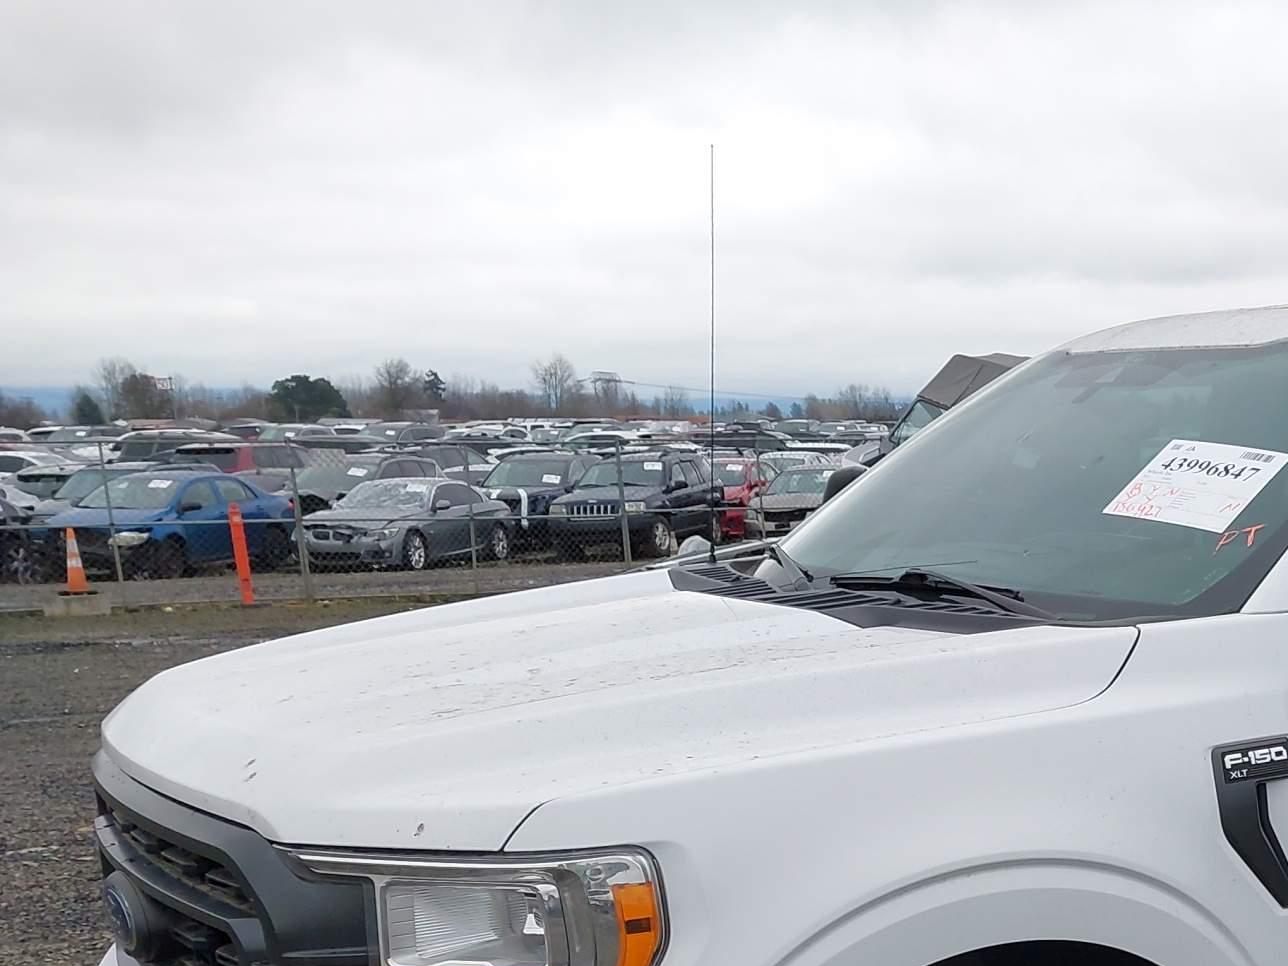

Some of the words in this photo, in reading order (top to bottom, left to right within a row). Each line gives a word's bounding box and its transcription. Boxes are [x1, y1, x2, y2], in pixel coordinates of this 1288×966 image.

[1161, 456, 1261, 482] 43996847
[1224, 746, 1288, 769] F-150
[1229, 769, 1248, 779] XLT
